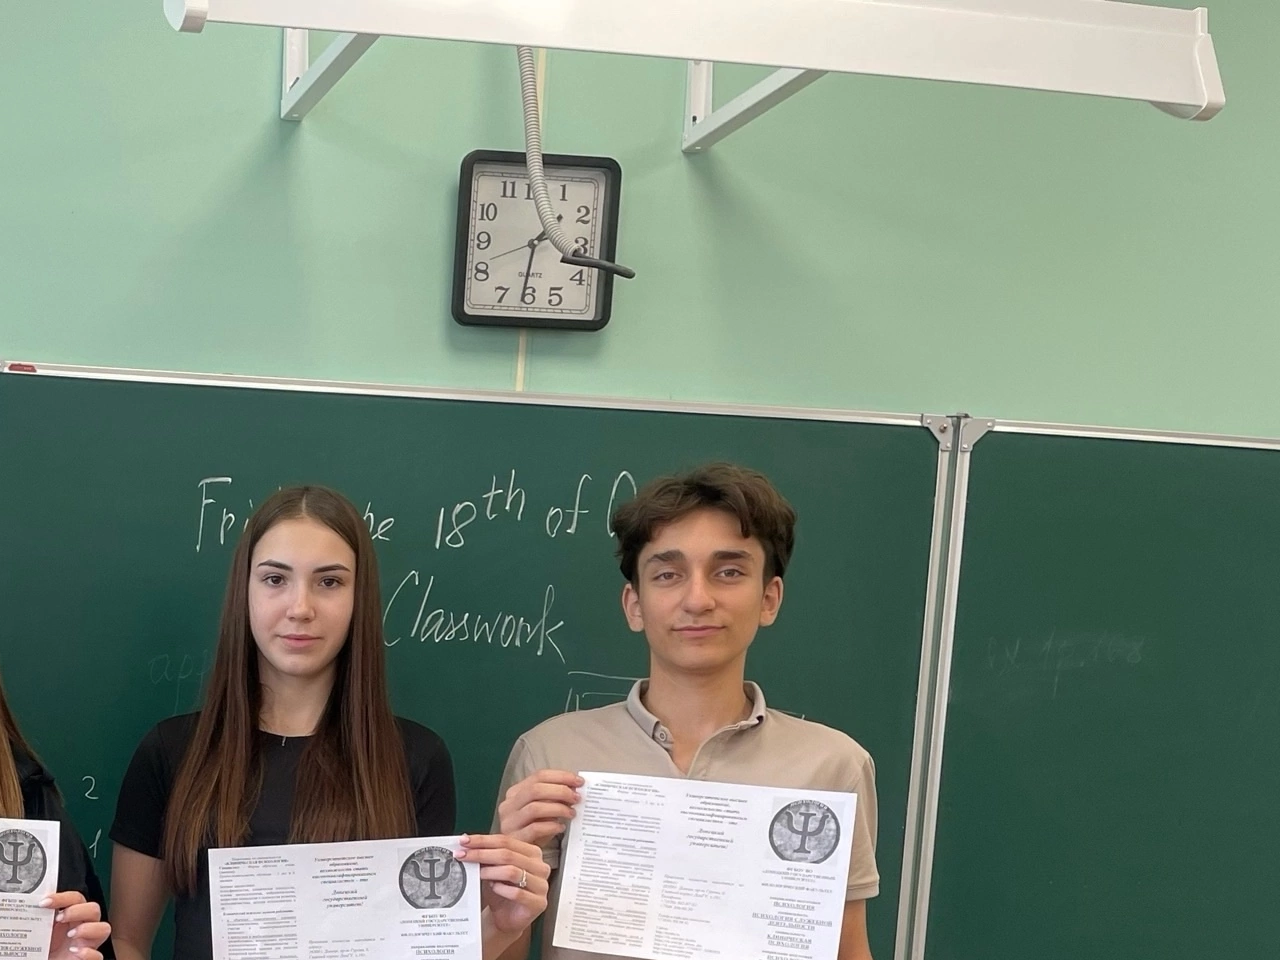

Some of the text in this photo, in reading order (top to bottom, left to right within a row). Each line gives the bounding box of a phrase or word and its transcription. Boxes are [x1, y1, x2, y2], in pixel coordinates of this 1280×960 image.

[500, 180, 518, 198] 11
[560, 184, 568, 201] 1
[478, 202, 498, 222] 10
[576, 205, 591, 225] 2
[476, 231, 492, 250] 9
[474, 261, 490, 282] 8
[569, 268, 586, 286] 4
[494, 286, 511, 304] 7
[522, 286, 537, 305] 6
[548, 286, 564, 306] 5
[545, 472, 592, 538] of
[81, 775, 99, 800] 2
[89, 828, 102, 859] 1
